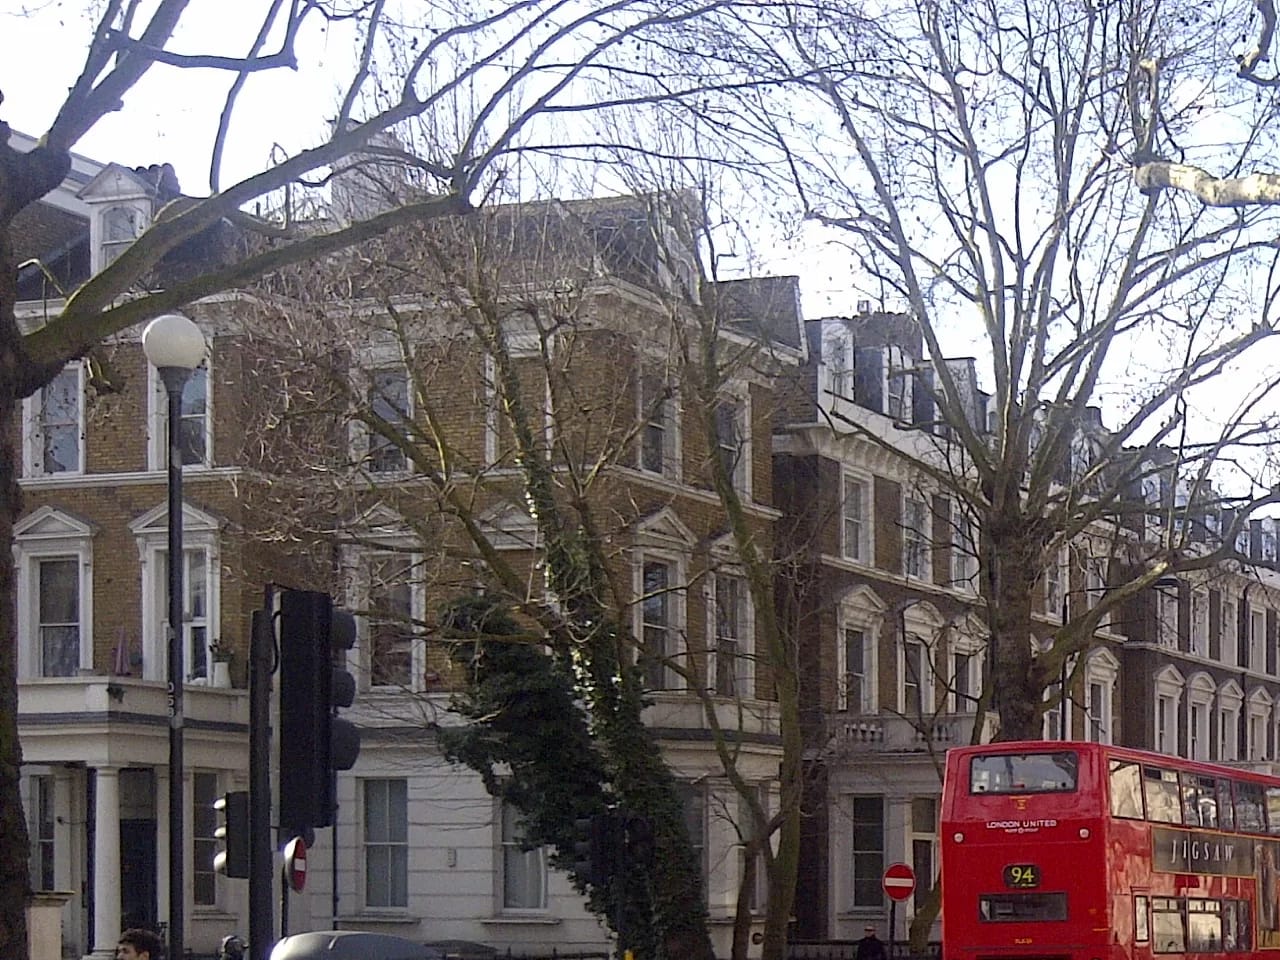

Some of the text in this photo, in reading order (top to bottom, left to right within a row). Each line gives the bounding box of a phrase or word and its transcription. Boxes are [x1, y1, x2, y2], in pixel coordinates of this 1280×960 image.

[986, 819, 1057, 829] LONDON UNITED
[1170, 839, 1235, 864] JIGSAW
[1011, 866, 1035, 883] 94
